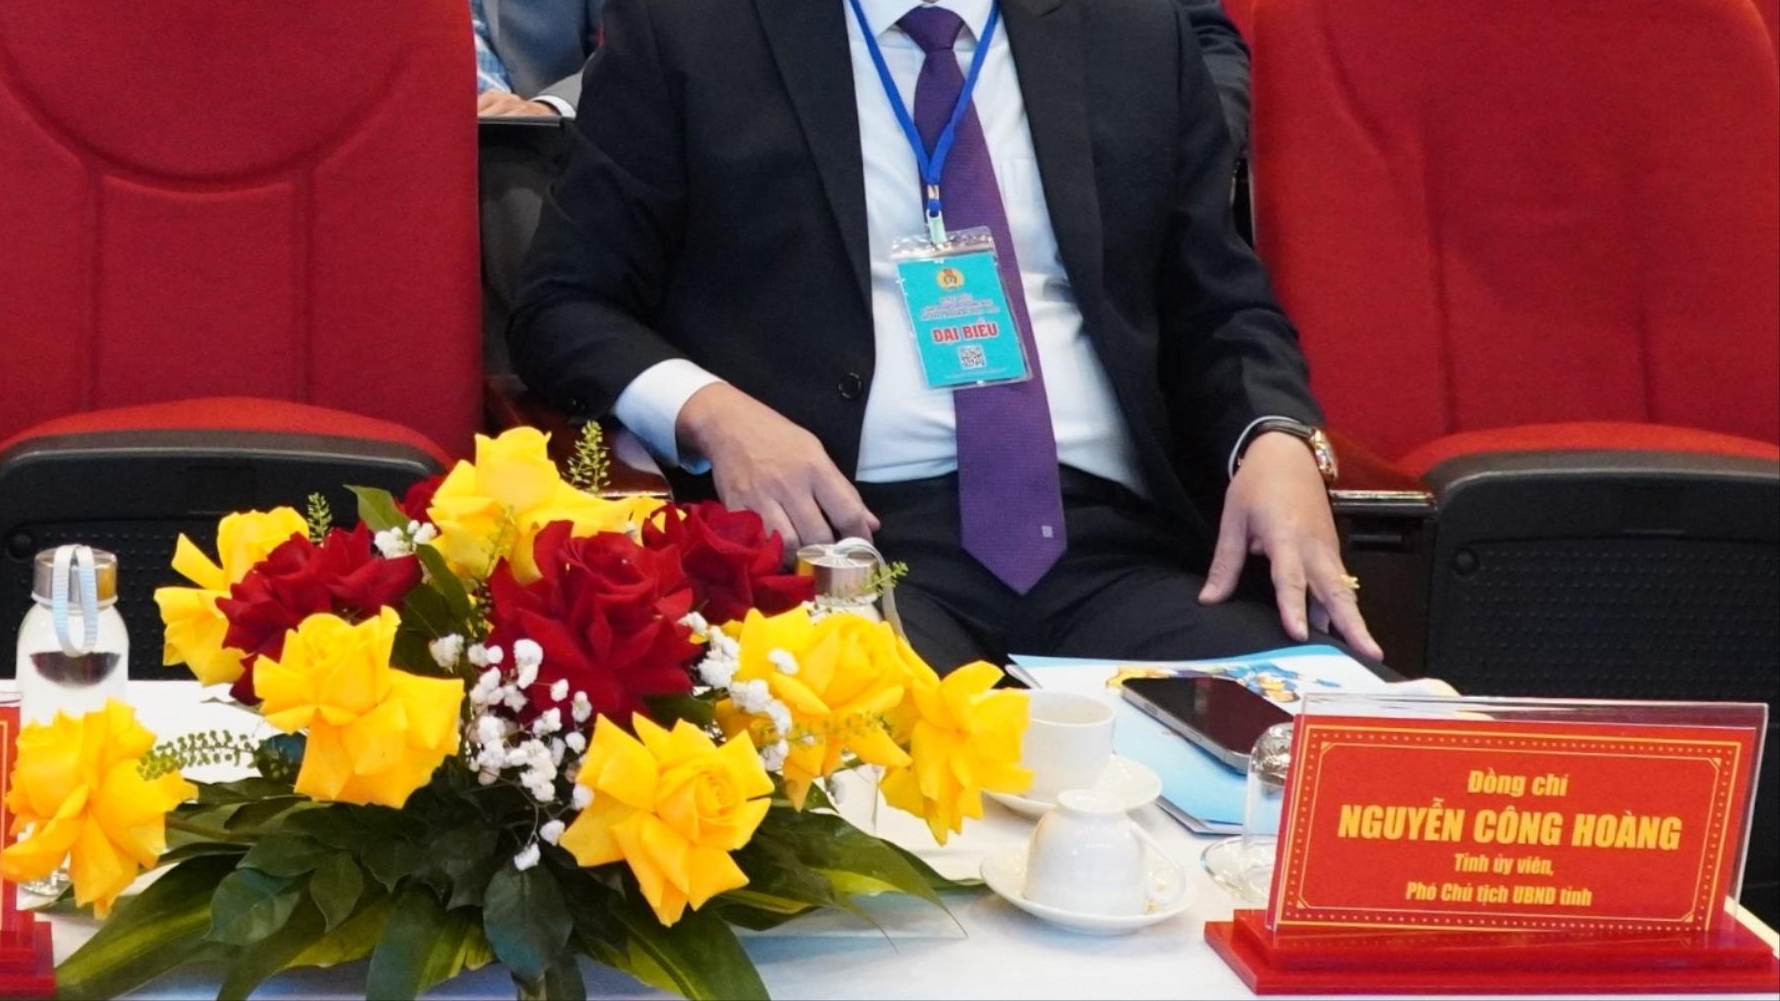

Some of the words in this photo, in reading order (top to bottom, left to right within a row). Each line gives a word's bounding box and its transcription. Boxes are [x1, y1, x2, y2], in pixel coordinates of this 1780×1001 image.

[1467, 767, 1526, 798] Đồng
[1531, 772, 1569, 797] chí
[1337, 797, 1465, 842] NGUYỄN
[1473, 804, 1564, 846] CÔNG
[1571, 809, 1683, 850] HOÀNG
[1454, 852, 1489, 873] Tỉnh
[1517, 856, 1555, 876] viên,
[1405, 881, 1437, 901] Phó
[1440, 882, 1473, 902] Chủ
[1477, 883, 1509, 906] tịch
[1512, 885, 1556, 905] UBND
[1560, 885, 1593, 906] tỉnh
